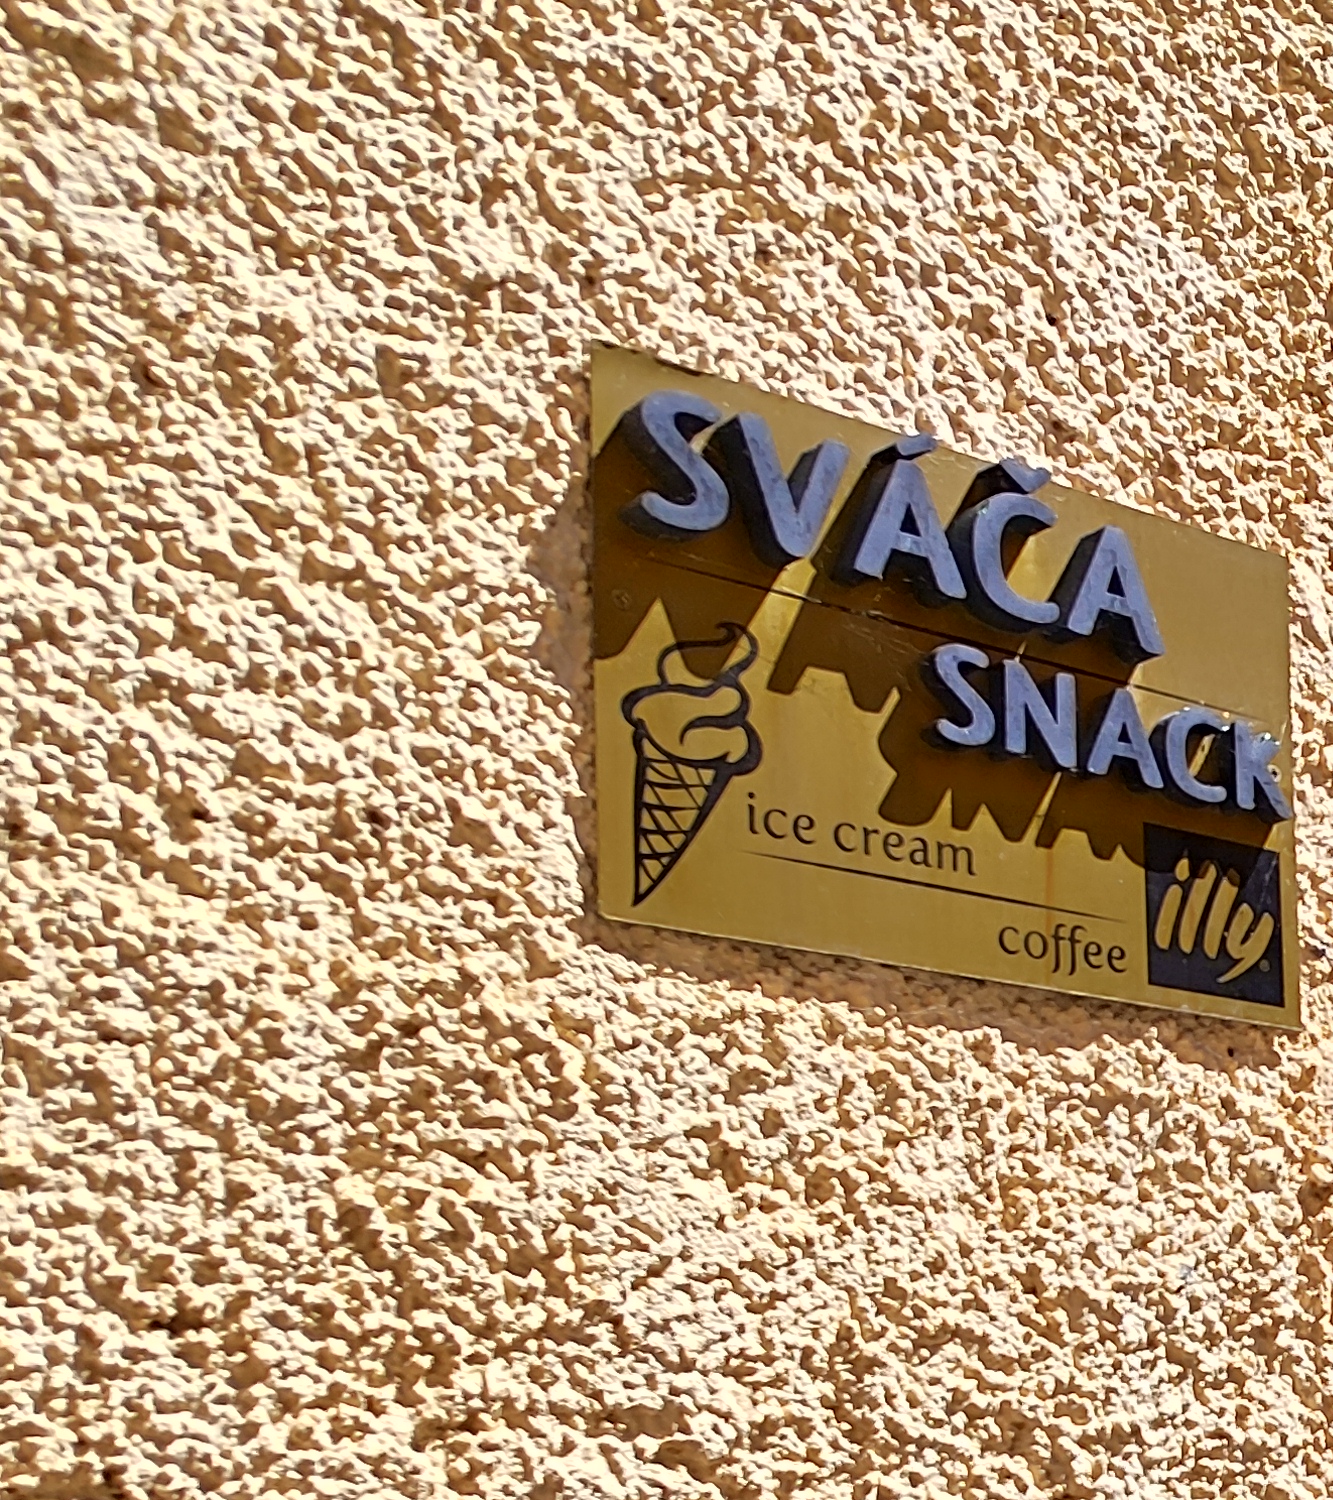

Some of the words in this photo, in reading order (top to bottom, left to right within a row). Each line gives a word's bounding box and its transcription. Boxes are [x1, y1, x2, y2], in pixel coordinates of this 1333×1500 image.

[640, 388, 1165, 657] SVÁČA
[932, 641, 1292, 820] SNACK
[746, 791, 817, 845] ice
[833, 813, 977, 877] cream
[998, 921, 1128, 975] coffee
[1154, 856, 1275, 985] illy
